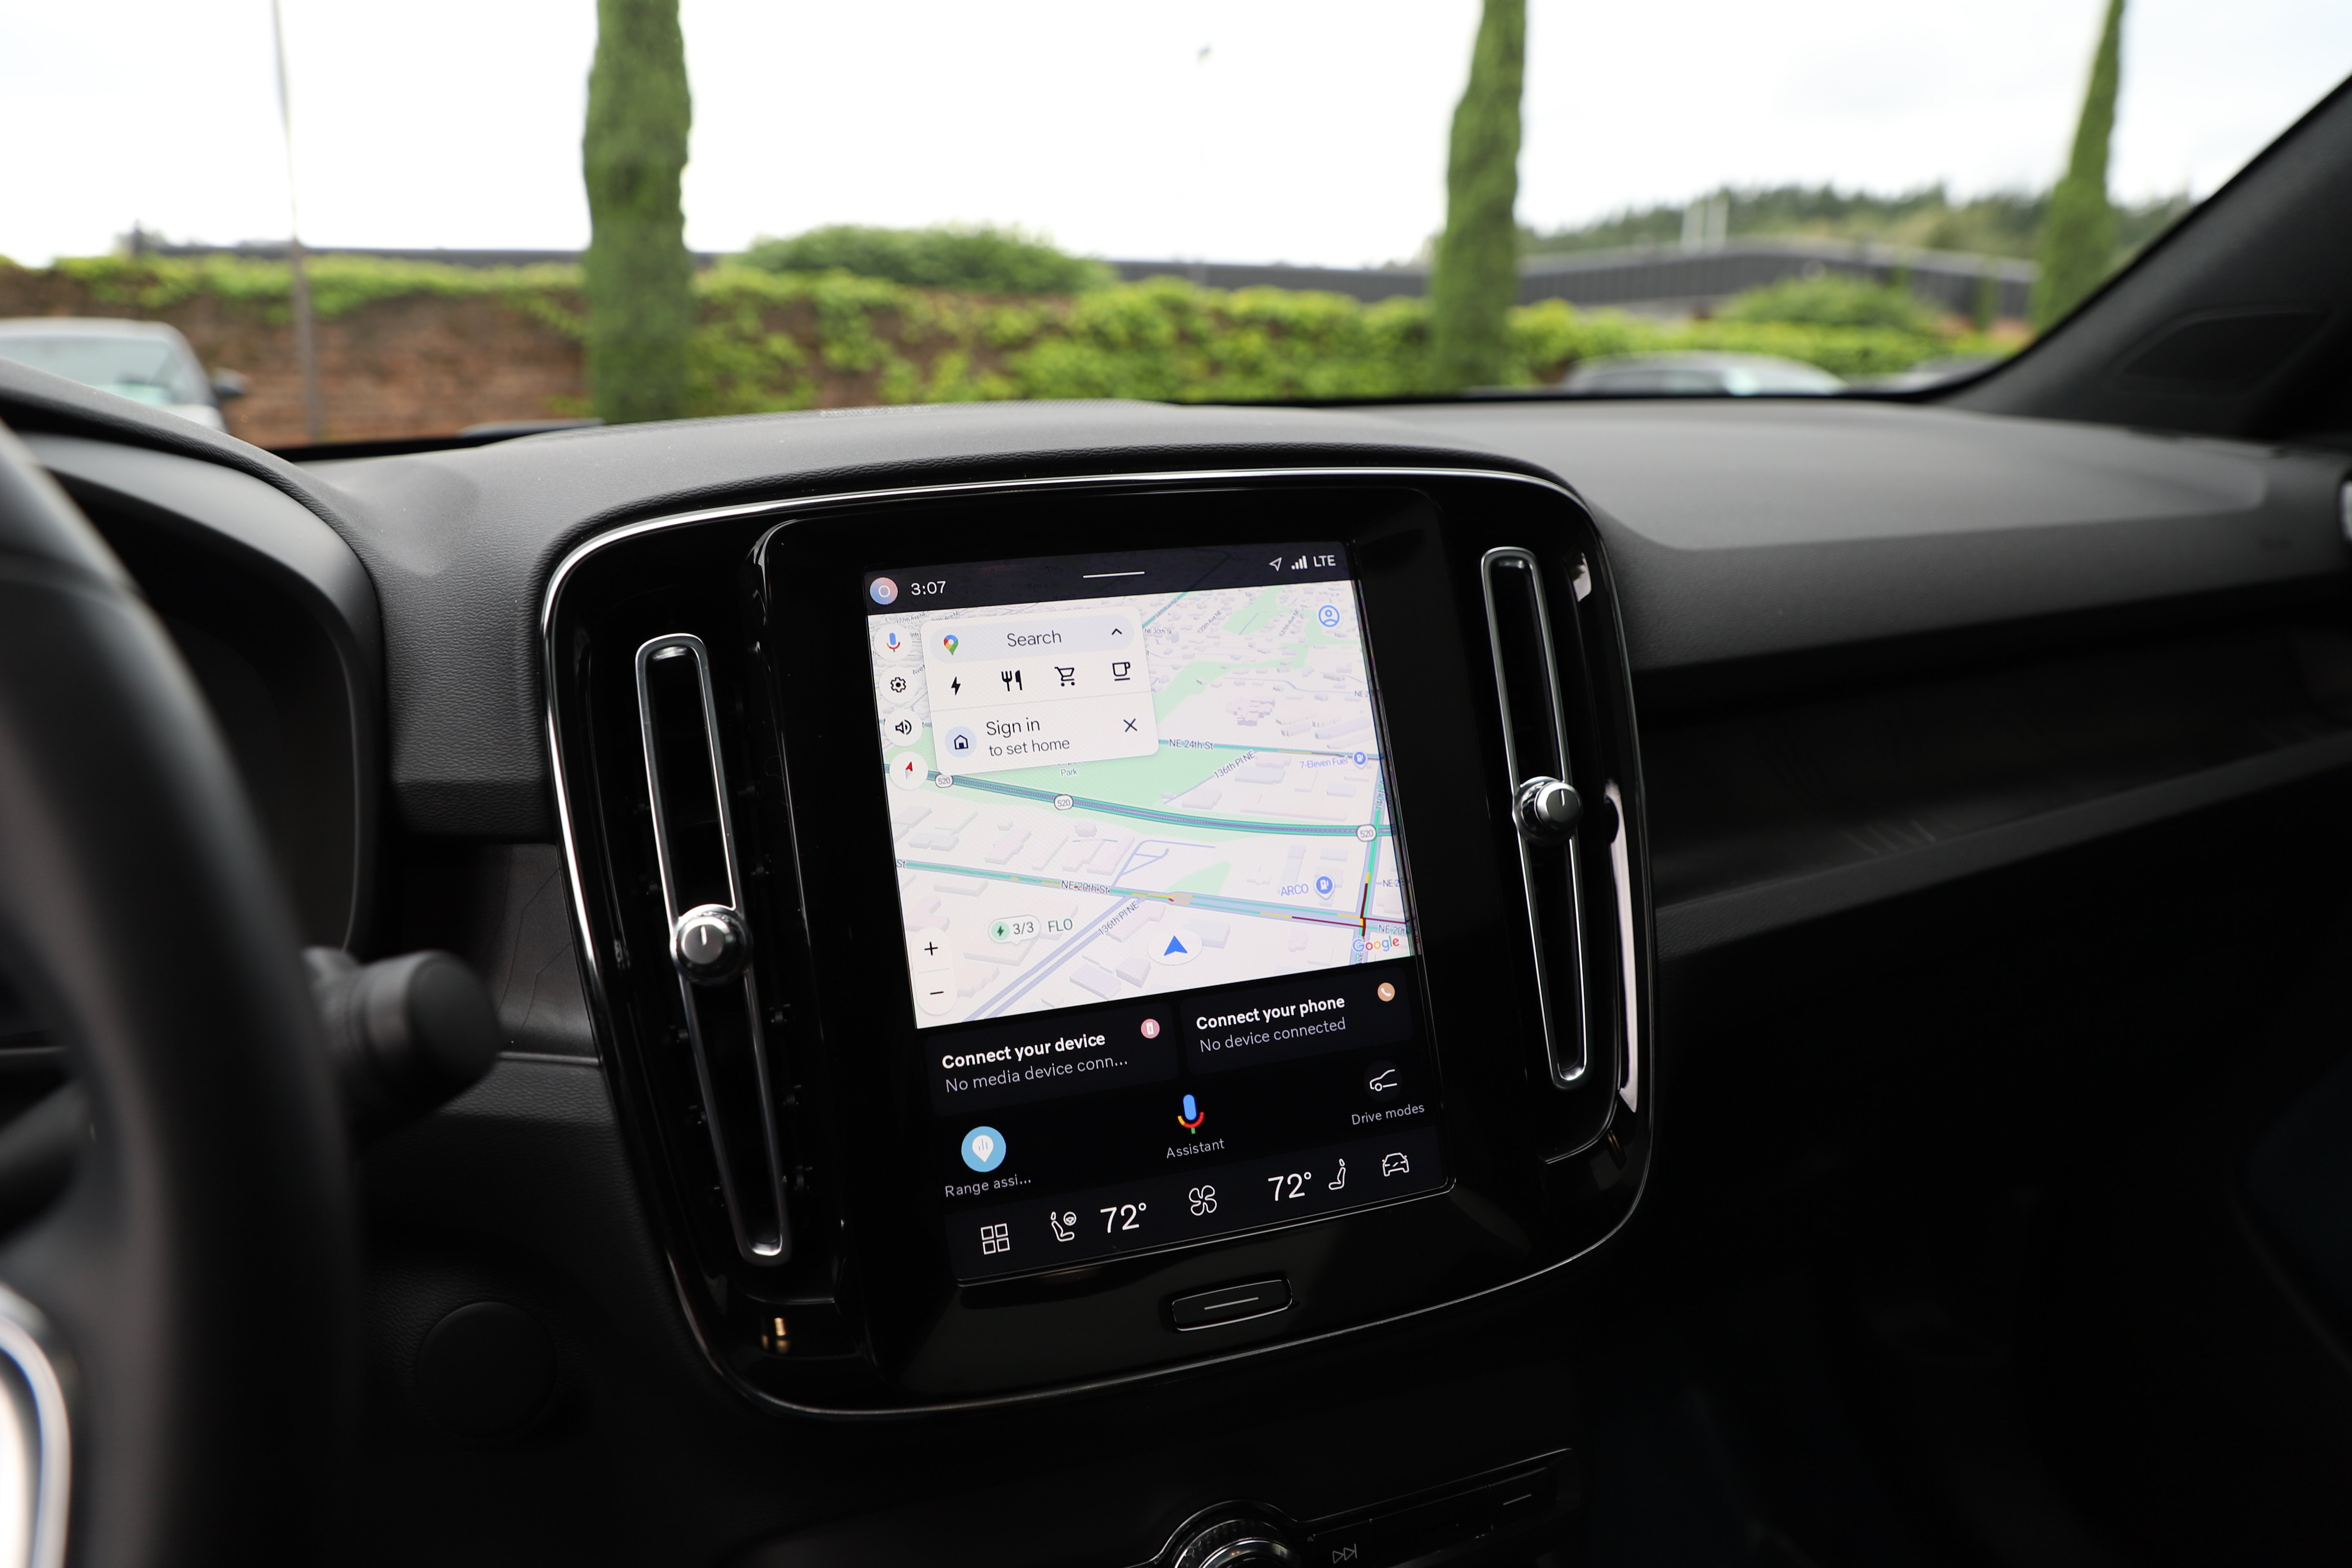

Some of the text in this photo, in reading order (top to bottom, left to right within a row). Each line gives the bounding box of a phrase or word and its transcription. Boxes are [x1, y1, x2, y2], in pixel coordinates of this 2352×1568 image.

[1314, 555, 1336, 567] LTE
[911, 581, 947, 595] 3:07
[1197, 609, 1222, 634] 135th Ave NE
[1007, 630, 1062, 647] Search
[986, 718, 1040, 739] Sign in
[989, 737, 1070, 757] to set home
[1169, 739, 1214, 750] NE 24th St
[1213, 762, 1236, 779] 136th
[1243, 750, 1256, 762] NE
[1300, 757, 1348, 769] 7-Eleven Fuel
[1061, 768, 1078, 776] Park
[1057, 799, 1071, 807] 520
[1360, 829, 1374, 838] 520
[896, 859, 906, 869] St
[1061, 880, 1108, 894] NE 20th St
[1281, 883, 1309, 896] ARCO
[1383, 879, 1393, 887] NE
[1048, 918, 1073, 933] FLO
[1098, 915, 1120, 935] 136th
[1126, 901, 1139, 914] NE
[1013, 921, 1034, 935] 3/3
[1379, 924, 1390, 933] NE
[1353, 935, 1400, 952] Google
[1196, 997, 1345, 1030] Connect your phone
[1200, 1017, 1346, 1052] No device connected
[942, 1033, 1106, 1069] Connect your device
[945, 1057, 1128, 1092] No media device conn...
[1352, 1102, 1425, 1125] Drive modes
[1166, 1138, 1225, 1158] Assistant
[945, 1179, 989, 1198] Range
[1267, 1172, 1312, 1201] 72°
[1100, 1202, 1147, 1233] 72°
